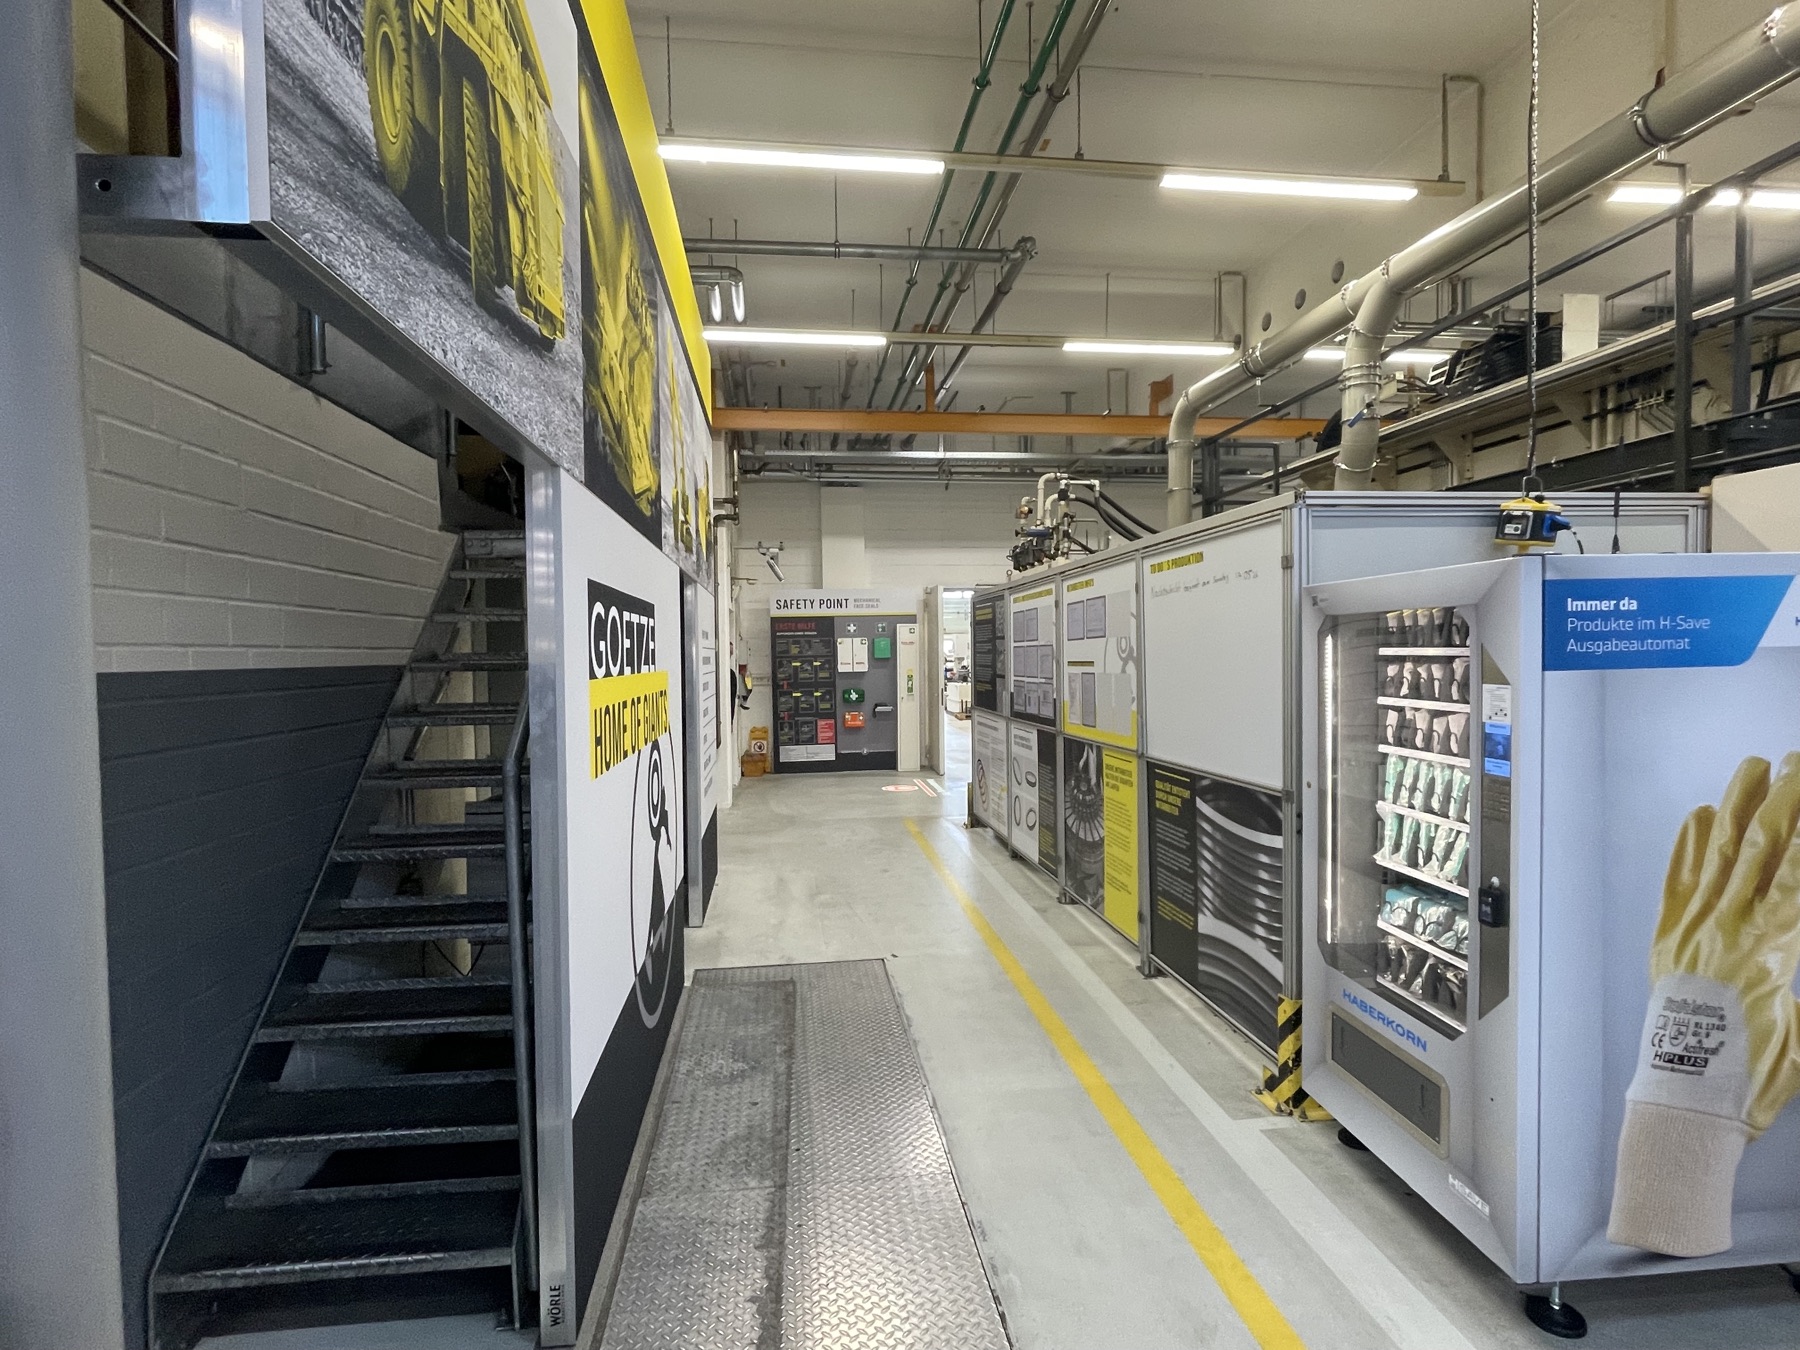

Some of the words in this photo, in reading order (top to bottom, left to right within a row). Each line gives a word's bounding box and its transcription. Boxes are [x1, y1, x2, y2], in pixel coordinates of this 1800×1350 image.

[1171, 551, 1204, 570] PRODUKTION
[775, 598, 815, 610] SAFETY
[819, 598, 849, 609] POINT
[1567, 598, 1617, 611] Immer
[1619, 597, 1638, 611] da
[1567, 617, 1633, 632] Produkte
[1637, 617, 1655, 631] im
[1659, 616, 1711, 630] H-Save
[590, 601, 656, 679] GOETZE
[1567, 637, 1691, 655] Ausgabeautomat
[594, 699, 629, 779] HOME
[630, 696, 641, 754] OF
[643, 689, 668, 747] GIANTS
[1342, 988, 1427, 1052] HABERKORN
[548, 1285, 560, 1327] WÖRLE
